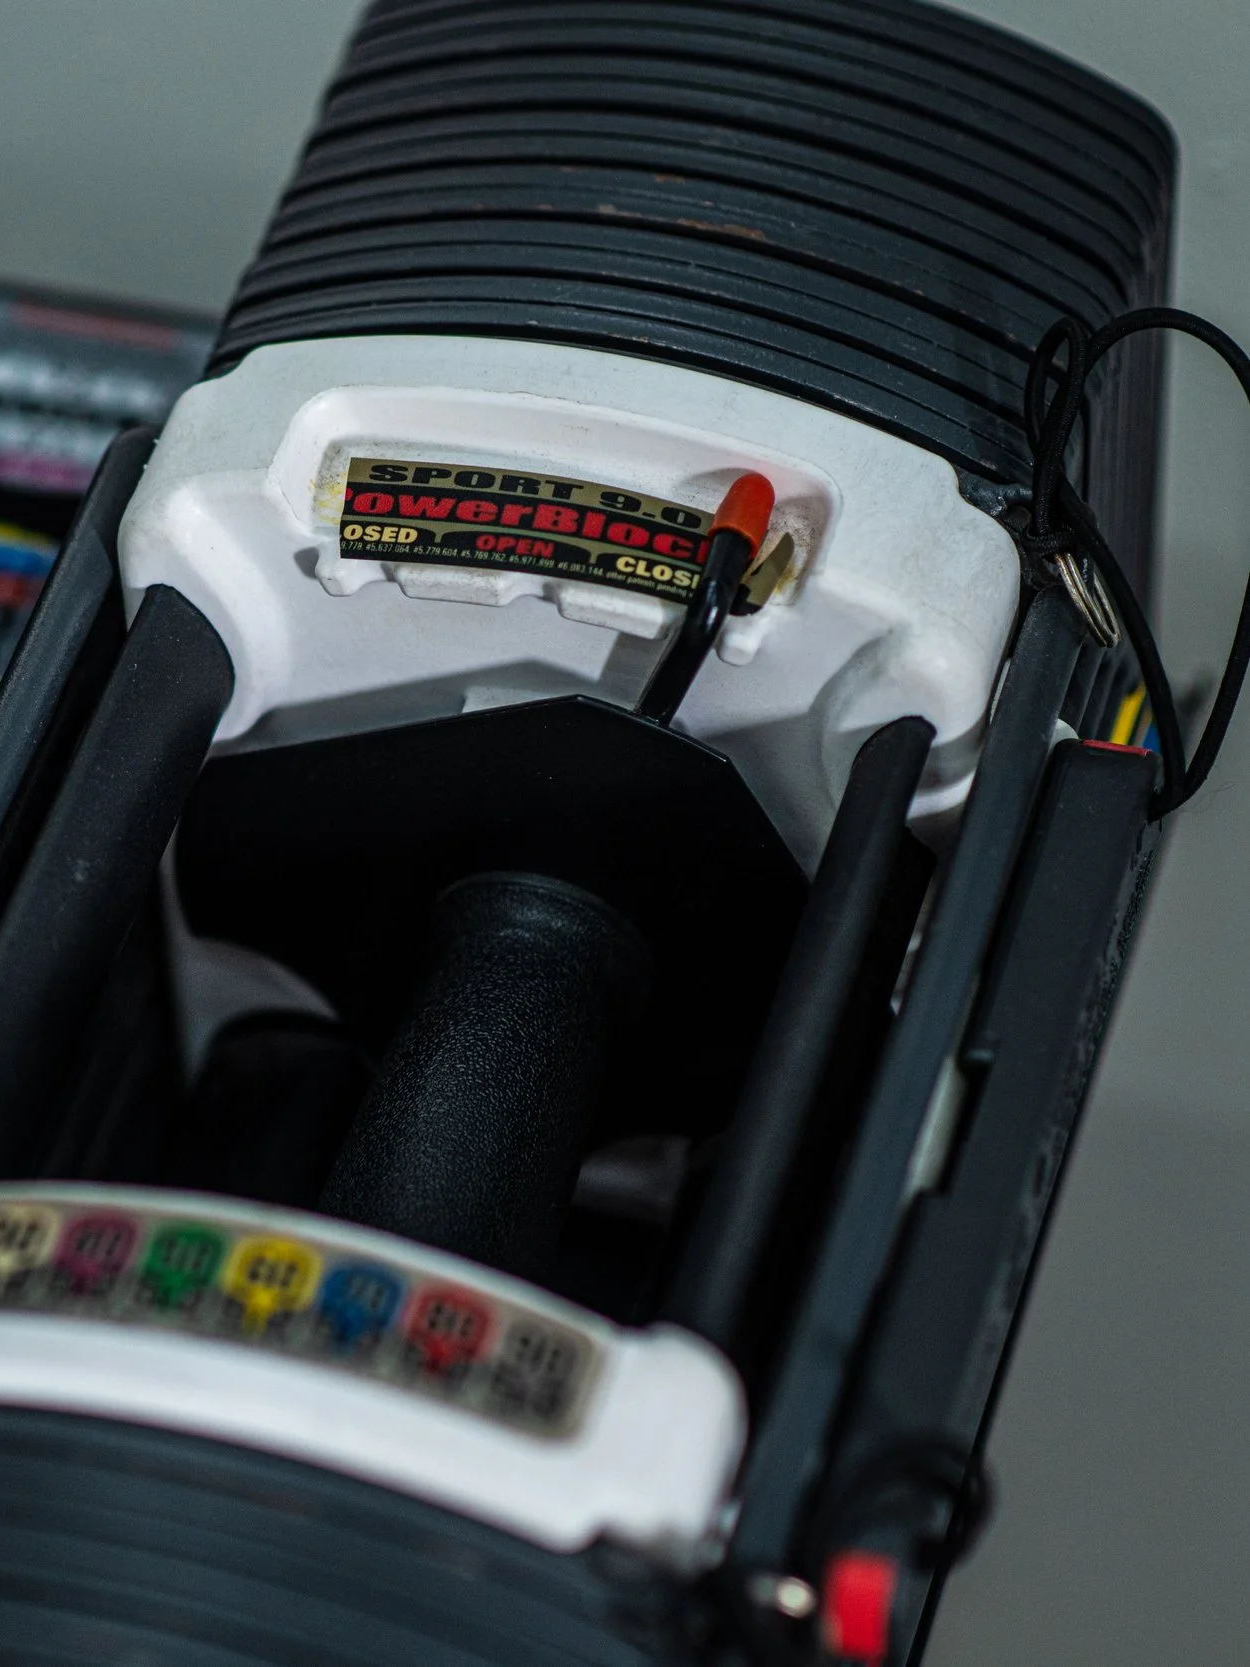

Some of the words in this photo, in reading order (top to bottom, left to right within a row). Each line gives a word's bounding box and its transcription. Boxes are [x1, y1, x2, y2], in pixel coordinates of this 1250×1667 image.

[345, 487, 709, 564] owerBloc
[369, 464, 584, 500] SPORT
[599, 491, 702, 529] 9.0
[476, 534, 555, 558] OPEN
